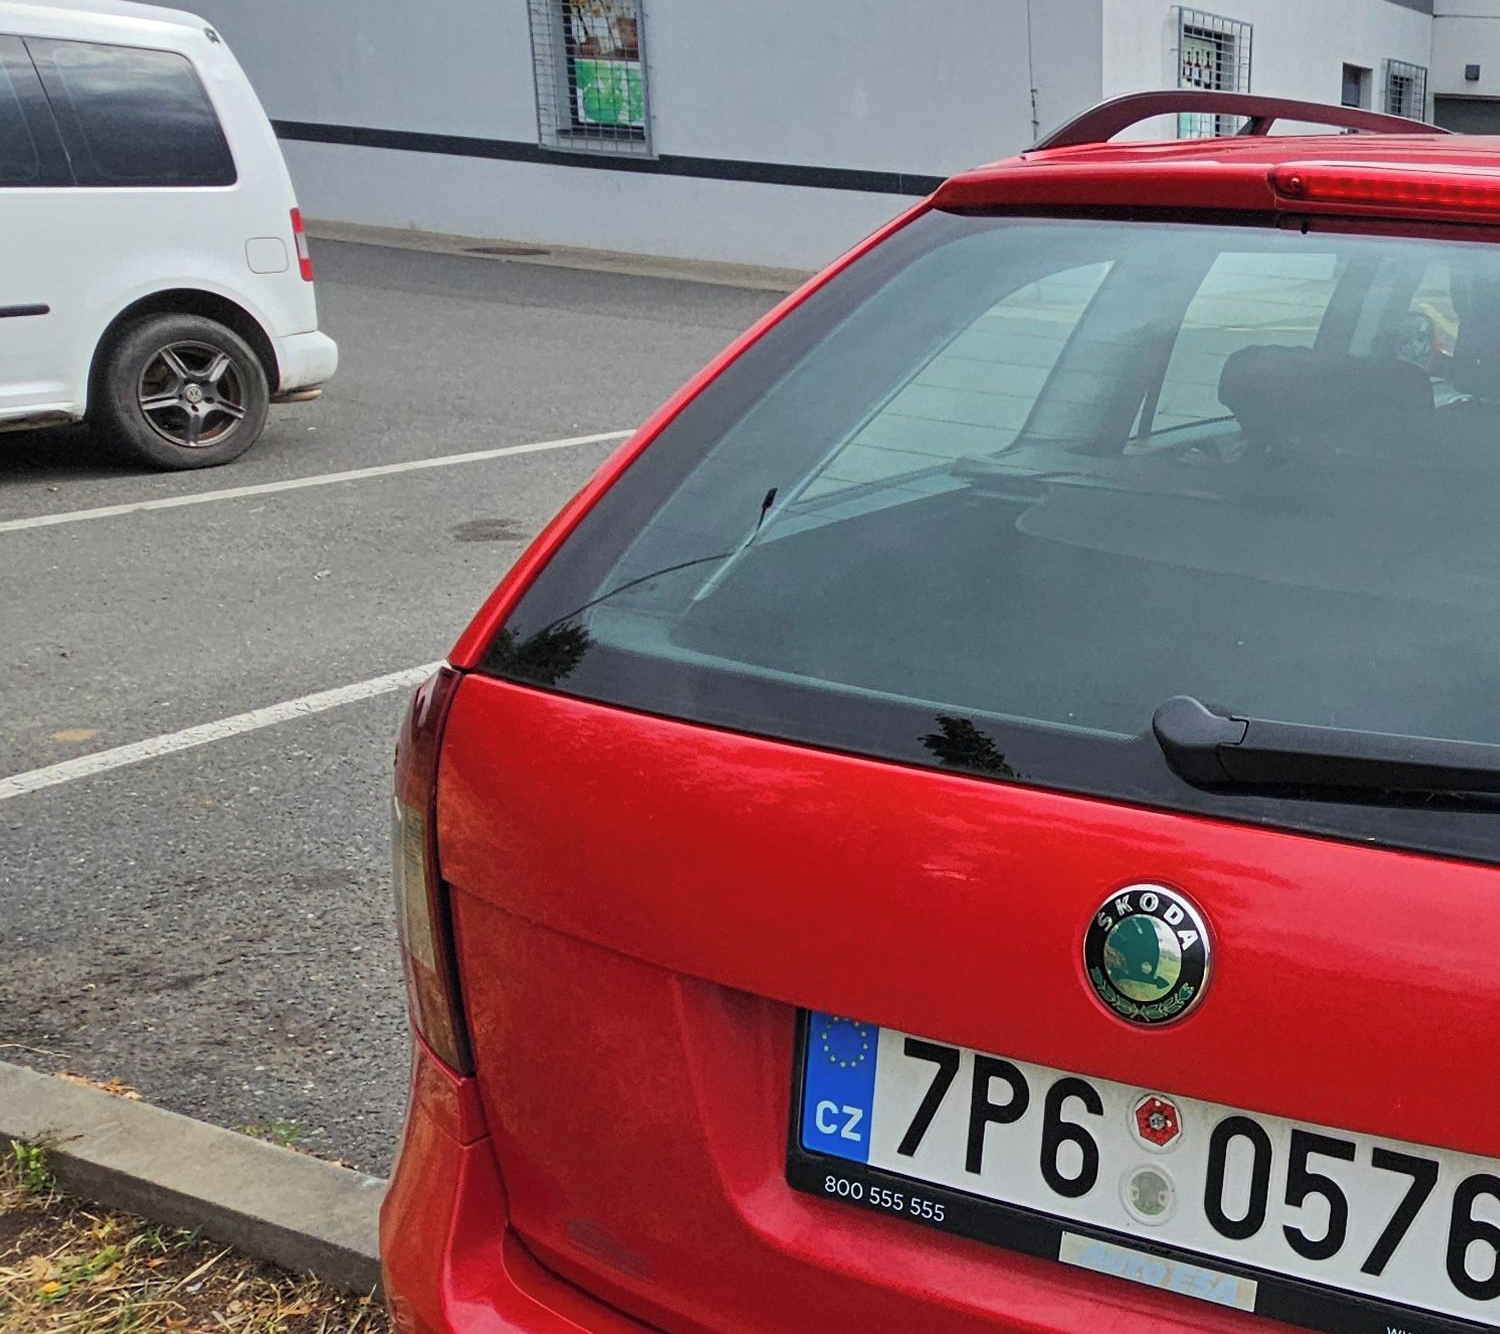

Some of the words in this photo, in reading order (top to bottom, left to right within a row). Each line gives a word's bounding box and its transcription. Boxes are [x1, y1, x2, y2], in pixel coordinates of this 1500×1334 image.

[815, 1100, 863, 1142] CZ
[897, 1038, 1103, 1198] 7P6
[824, 1175, 863, 1200] 800
[869, 1186, 904, 1211] 555
[910, 1197, 945, 1222] 555
